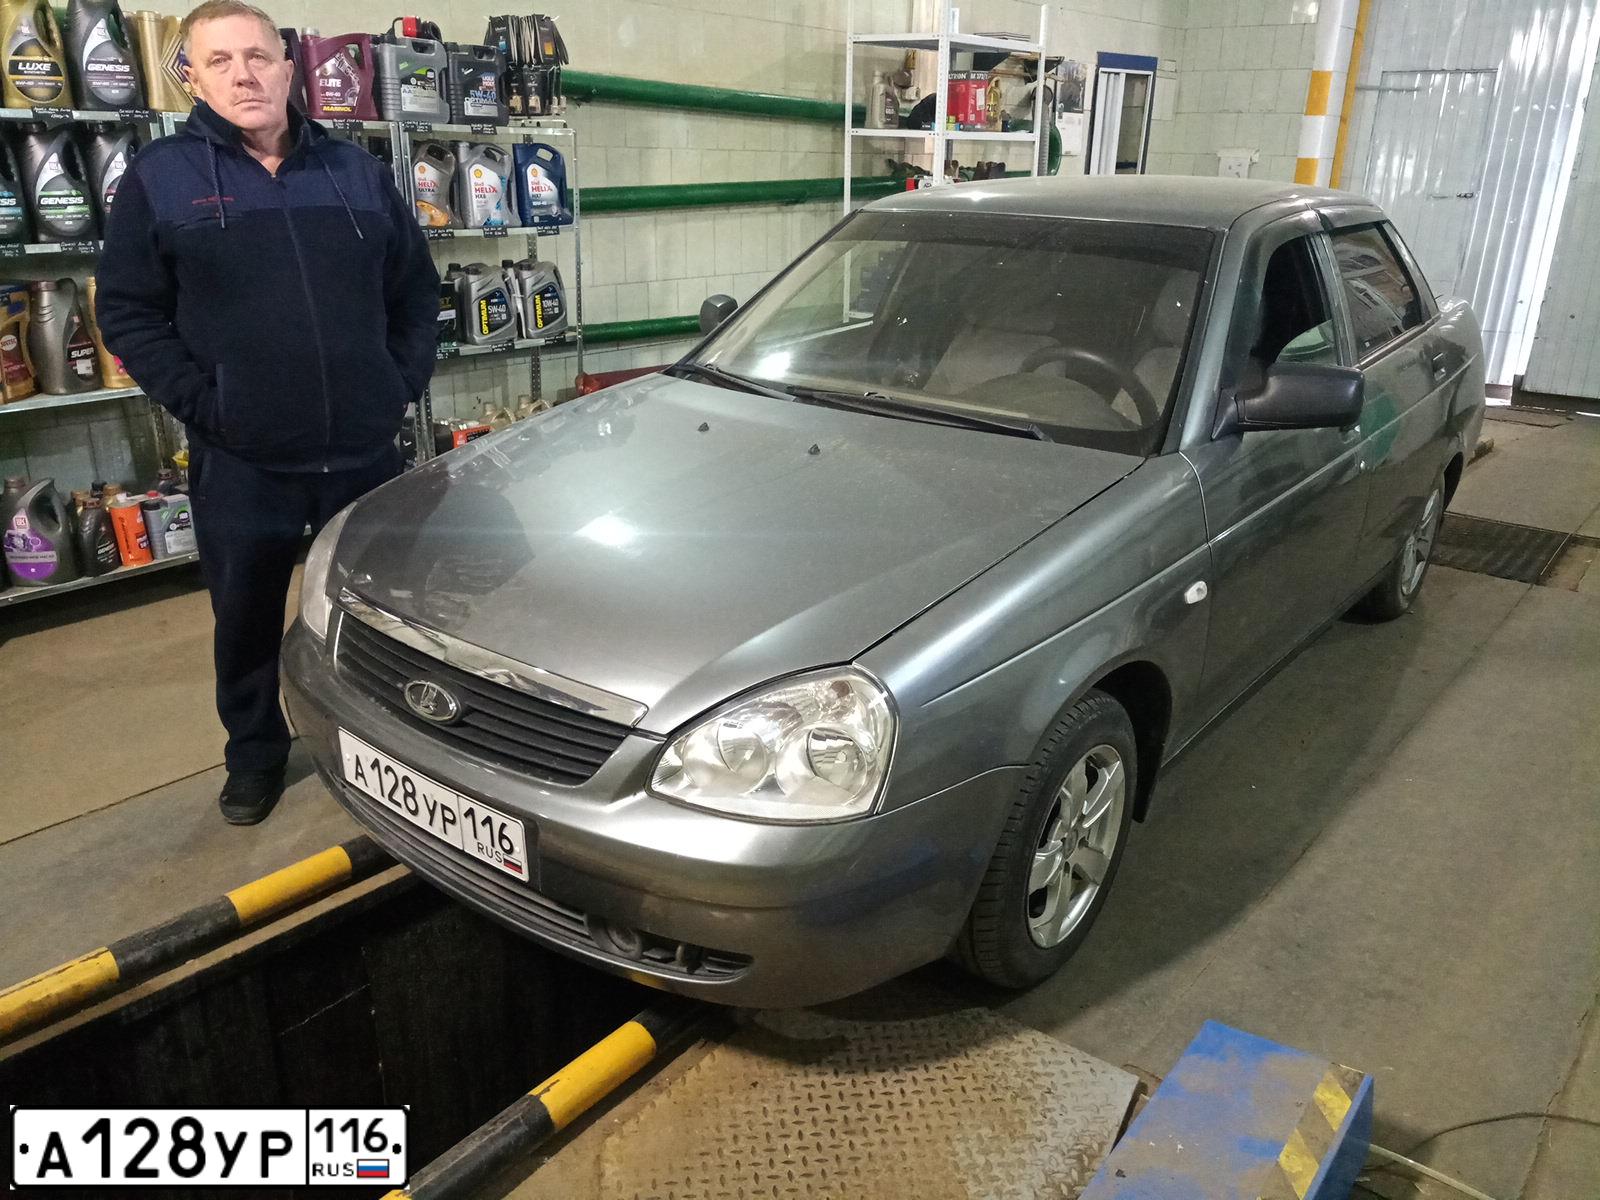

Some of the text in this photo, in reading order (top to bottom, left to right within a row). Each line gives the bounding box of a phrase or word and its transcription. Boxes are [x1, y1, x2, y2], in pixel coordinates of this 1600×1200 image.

[18, 62, 51, 70] LUXE
[87, 63, 130, 73] GENESIS
[319, 78, 342, 88] ELITE
[417, 180, 438, 188] HELIX
[531, 184, 553, 193] HELIX
[474, 185, 498, 194] HELIX
[40, 196, 85, 205] GENESIS
[487, 304, 507, 314] 5W-40
[71, 347, 94, 358] SUPER
[463, 806, 514, 855] 116
[477, 841, 503, 863] RUS
